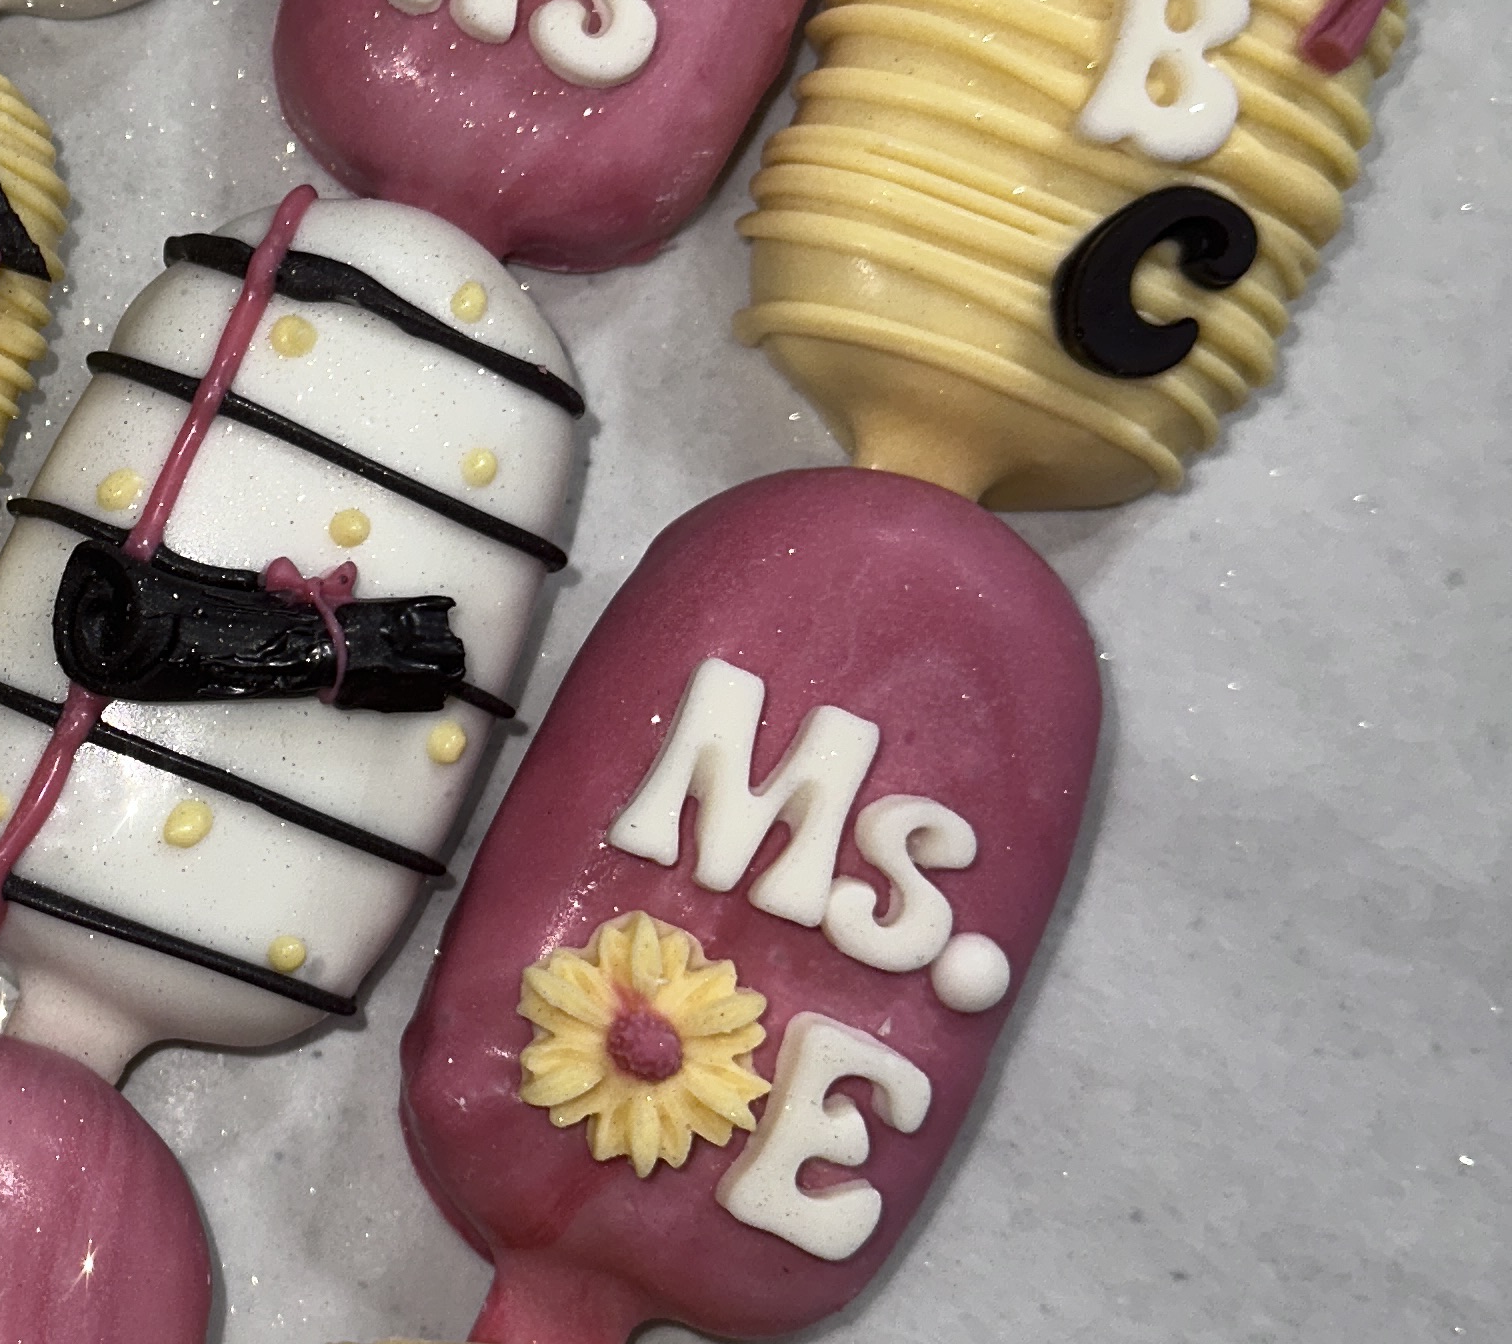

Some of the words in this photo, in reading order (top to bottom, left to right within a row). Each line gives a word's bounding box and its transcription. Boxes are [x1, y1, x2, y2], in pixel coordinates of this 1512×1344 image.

[1053, 185, 1258, 379] C
[607, 657, 1010, 1013] Ms.
[715, 1011, 931, 1260] E
